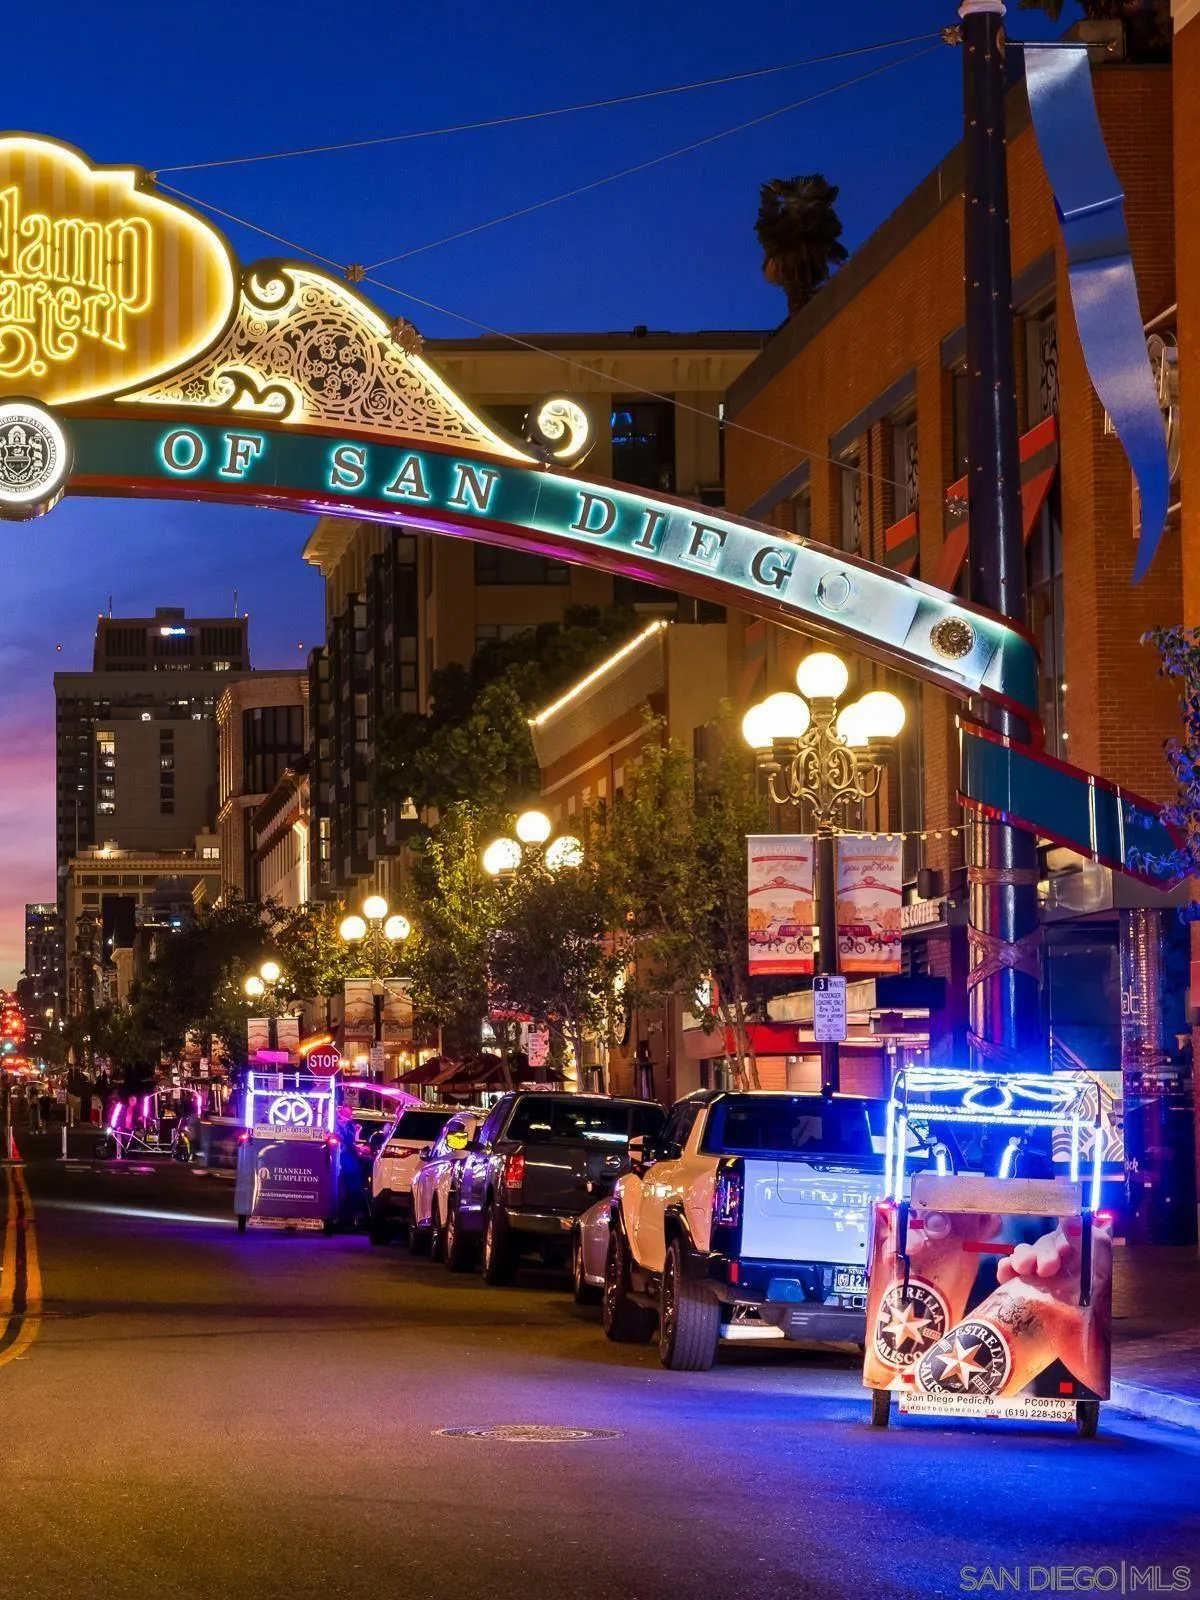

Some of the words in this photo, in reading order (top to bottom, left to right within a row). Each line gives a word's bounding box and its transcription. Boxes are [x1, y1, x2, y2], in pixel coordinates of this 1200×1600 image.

[163, 430, 262, 477] OF
[330, 446, 501, 510] SAN
[571, 491, 853, 612] DIEGO
[910, 901, 940, 926] COFFEE
[819, 978, 825, 990] 3
[310, 1054, 339, 1068] STOP
[273, 1167, 312, 1175] FRANKLIN
[273, 1174, 319, 1183] TEMPLETON
[258, 1191, 315, 1200] ranklintempleton.com
[955, 1325, 1003, 1378] ESTRELLA
[906, 1393, 924, 1402] San
[927, 1394, 954, 1405] Diego
[957, 1396, 994, 1405] Pedicab
[1024, 1398, 1066, 1408] PC00170
[1005, 1408, 1028, 1418] (619)
[1031, 1409, 1073, 1420] 228-3632
